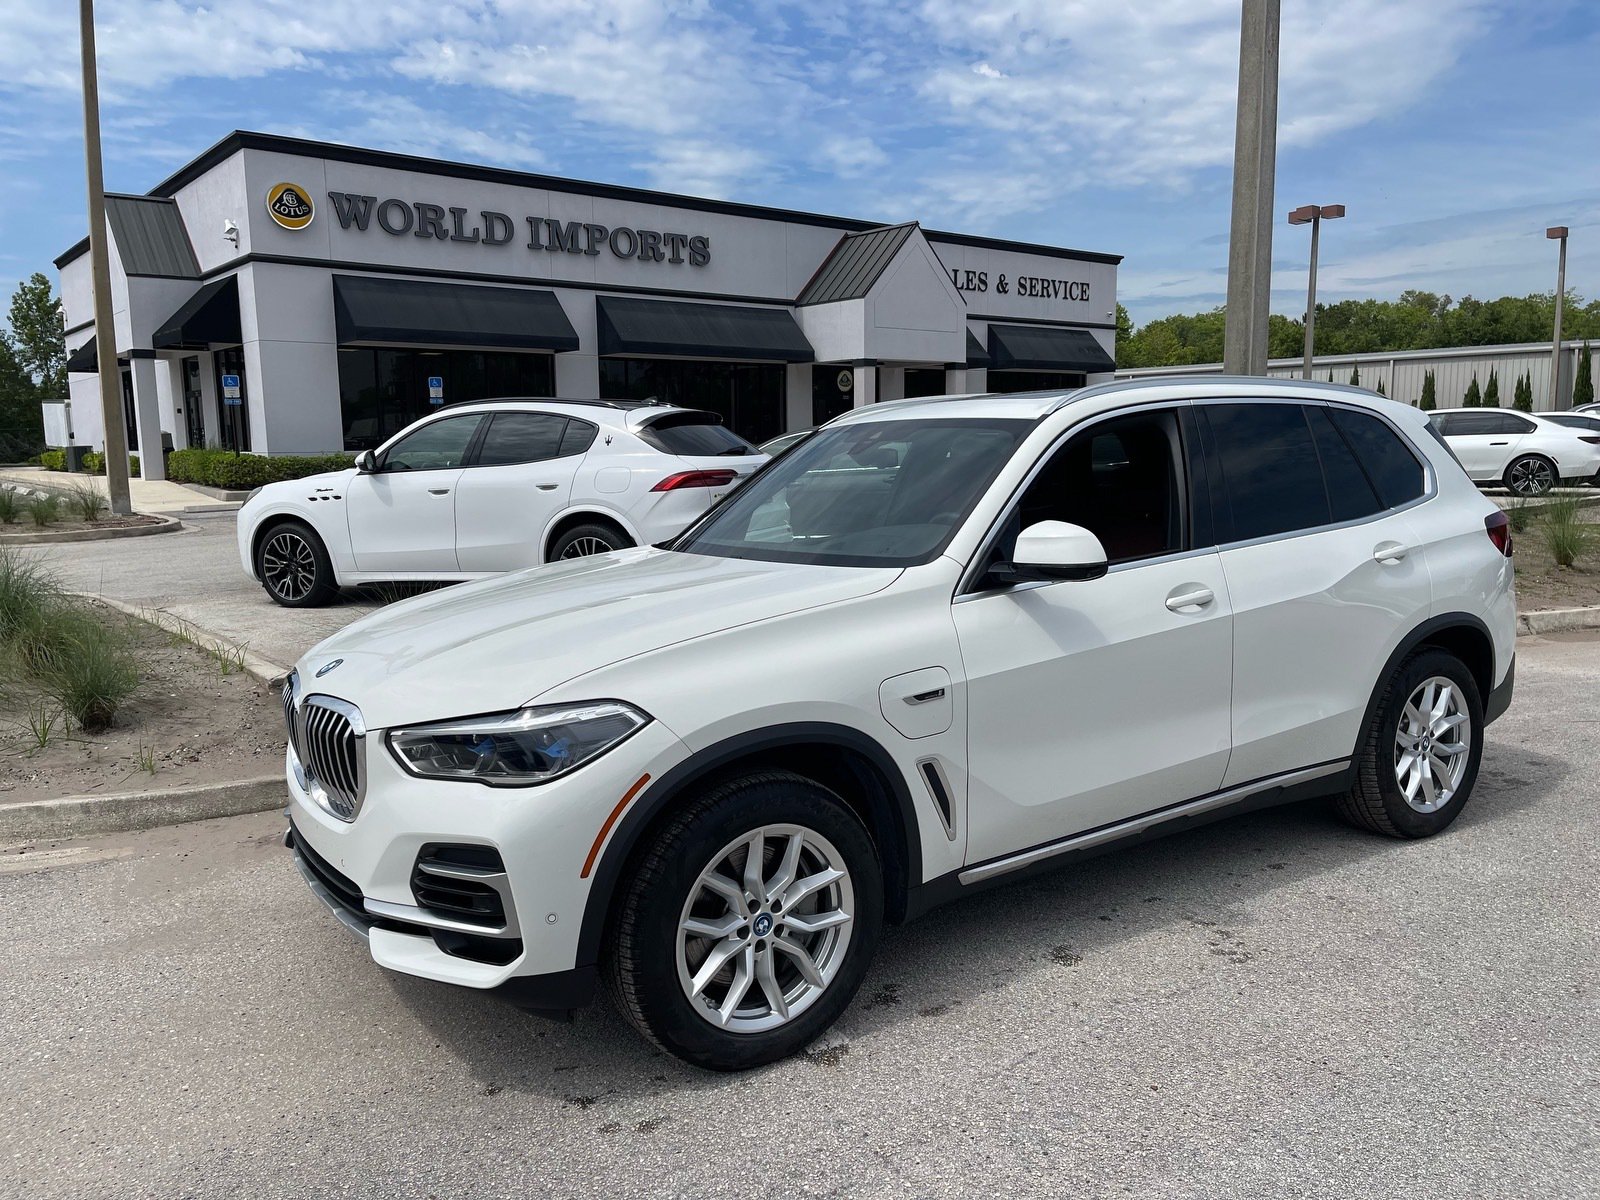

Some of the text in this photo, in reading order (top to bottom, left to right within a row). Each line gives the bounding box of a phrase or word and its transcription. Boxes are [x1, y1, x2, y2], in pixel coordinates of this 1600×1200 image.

[274, 203, 309, 215] LOTUS
[328, 191, 711, 266] WORLD IMPORTS
[996, 274, 1009, 294] &
[1017, 276, 1090, 301] SERVICE
